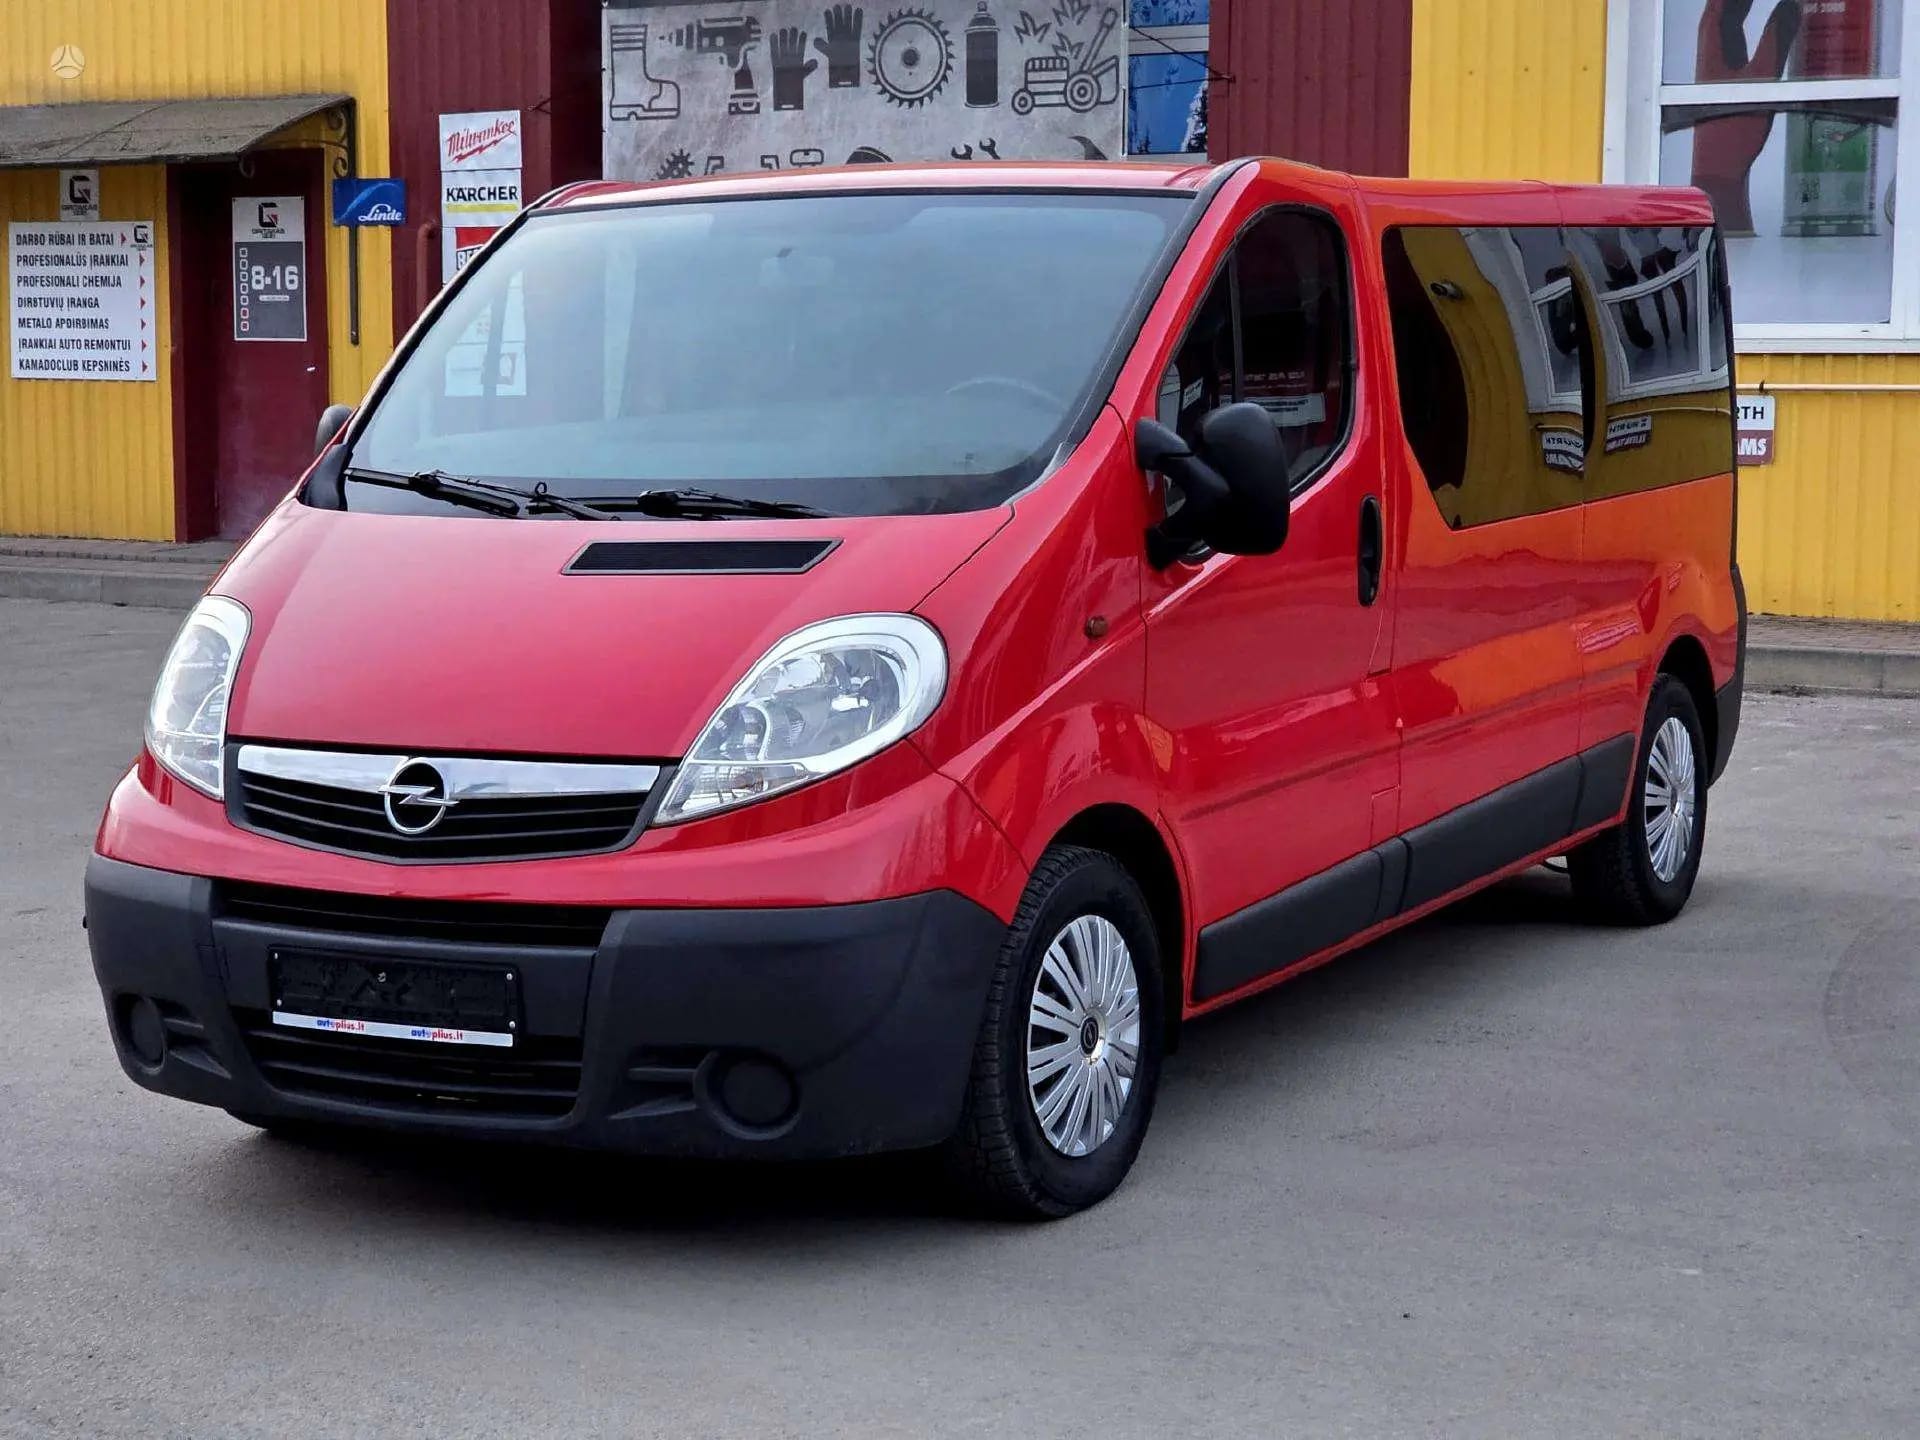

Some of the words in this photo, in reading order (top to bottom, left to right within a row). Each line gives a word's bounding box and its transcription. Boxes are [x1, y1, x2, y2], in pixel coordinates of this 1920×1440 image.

[446, 118, 518, 157] Milwaukee
[358, 203, 402, 222] Linde
[16, 233, 45, 246] DARBO
[78, 233, 86, 246] IR
[89, 233, 114, 246] BATAI
[16, 253, 87, 267] PROFESIONALŪS
[90, 254, 129, 270] ĮRANKIAI
[16, 275, 80, 288] PROFESIONALI
[82, 275, 122, 288] CHEMIJA
[67, 297, 100, 312] ĮRANGA
[18, 317, 52, 329] METALO
[55, 317, 109, 330] APDIRBIMAS
[18, 338, 57, 353] ĮRANKIAI
[59, 339, 82, 350] AUTO
[84, 339, 131, 351] REMONTUI
[19, 358, 79, 371] KAMADOCLUB
[81, 357, 130, 372] KEPSNINĖS
